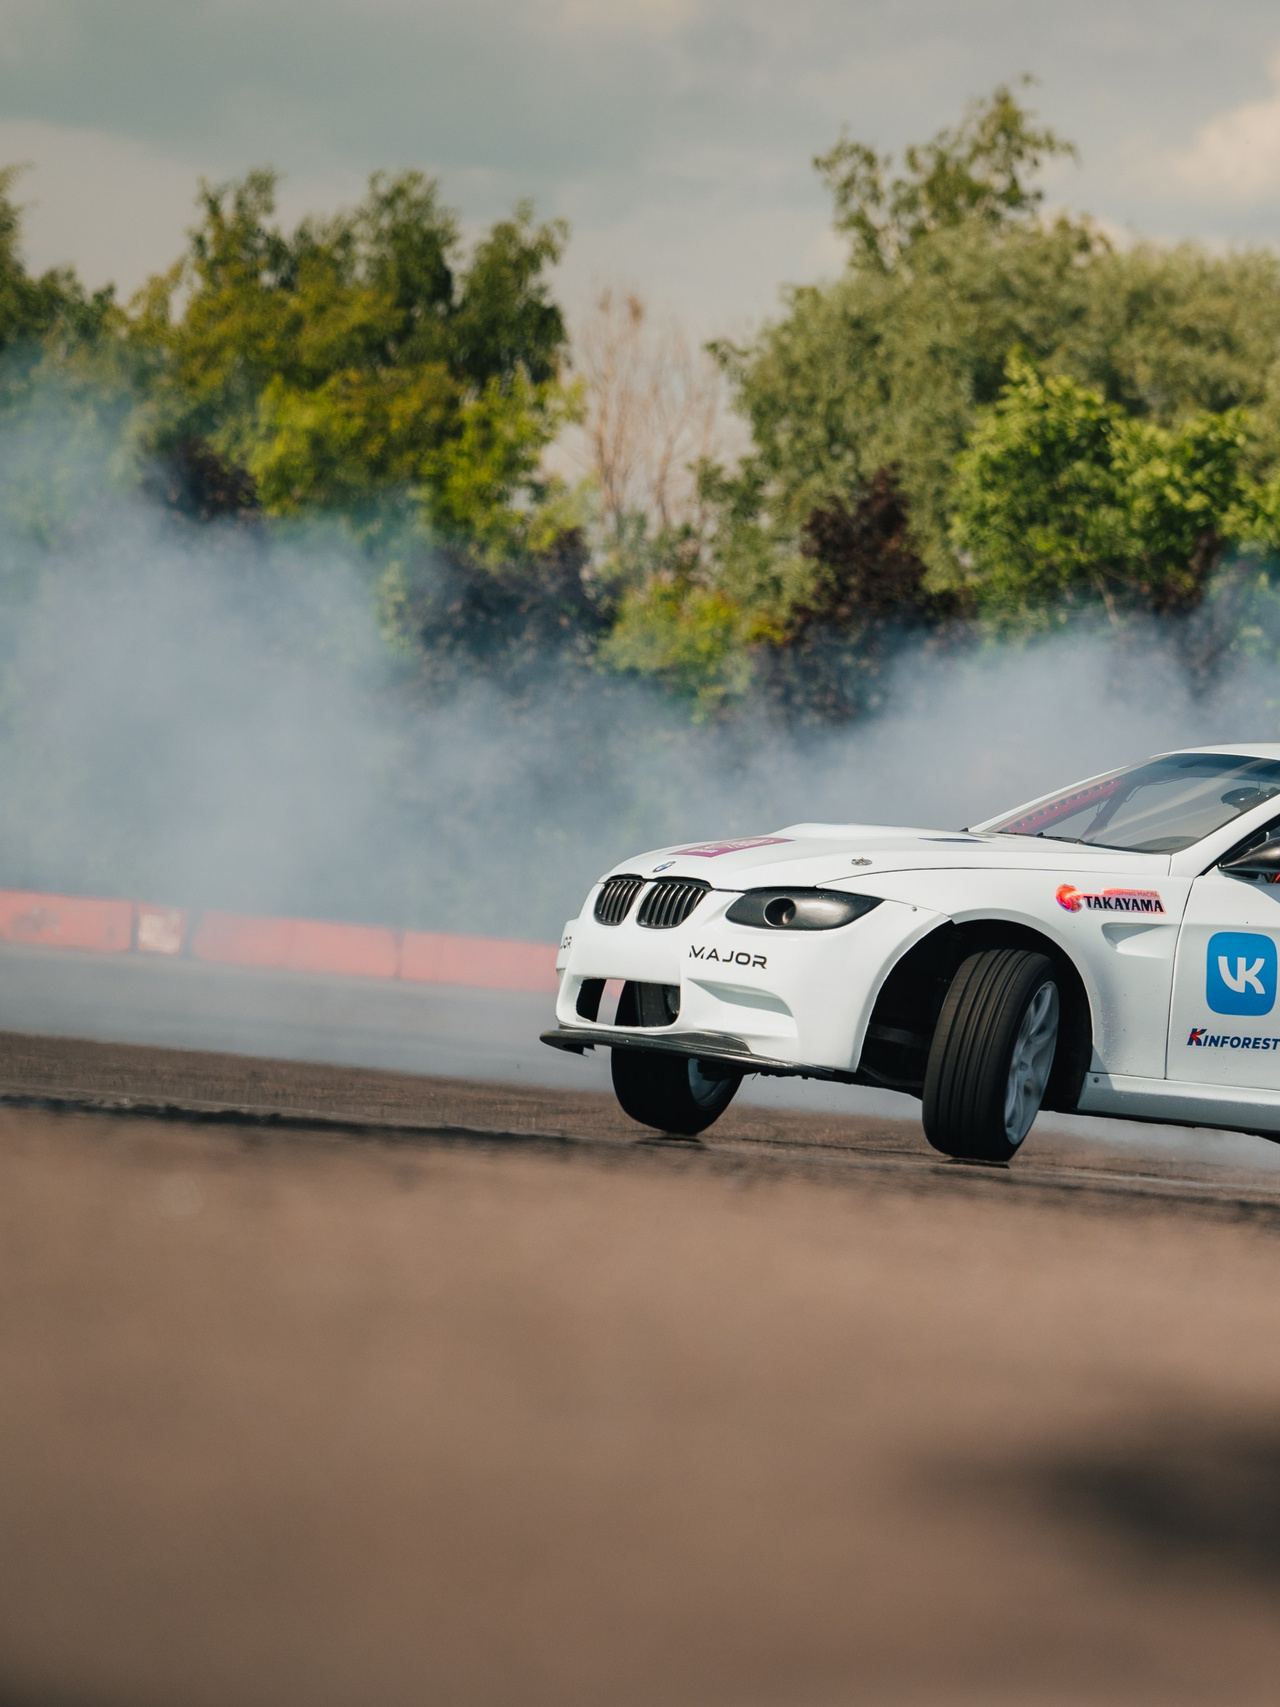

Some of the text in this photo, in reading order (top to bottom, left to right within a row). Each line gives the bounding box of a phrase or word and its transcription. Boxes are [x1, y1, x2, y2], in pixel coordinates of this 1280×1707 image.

[1083, 896, 1164, 912] TAKAYAMA
[689, 945, 768, 970] MAJOR
[1217, 955, 1266, 995] VK
[1186, 1028, 1280, 1051] KINFOREST
